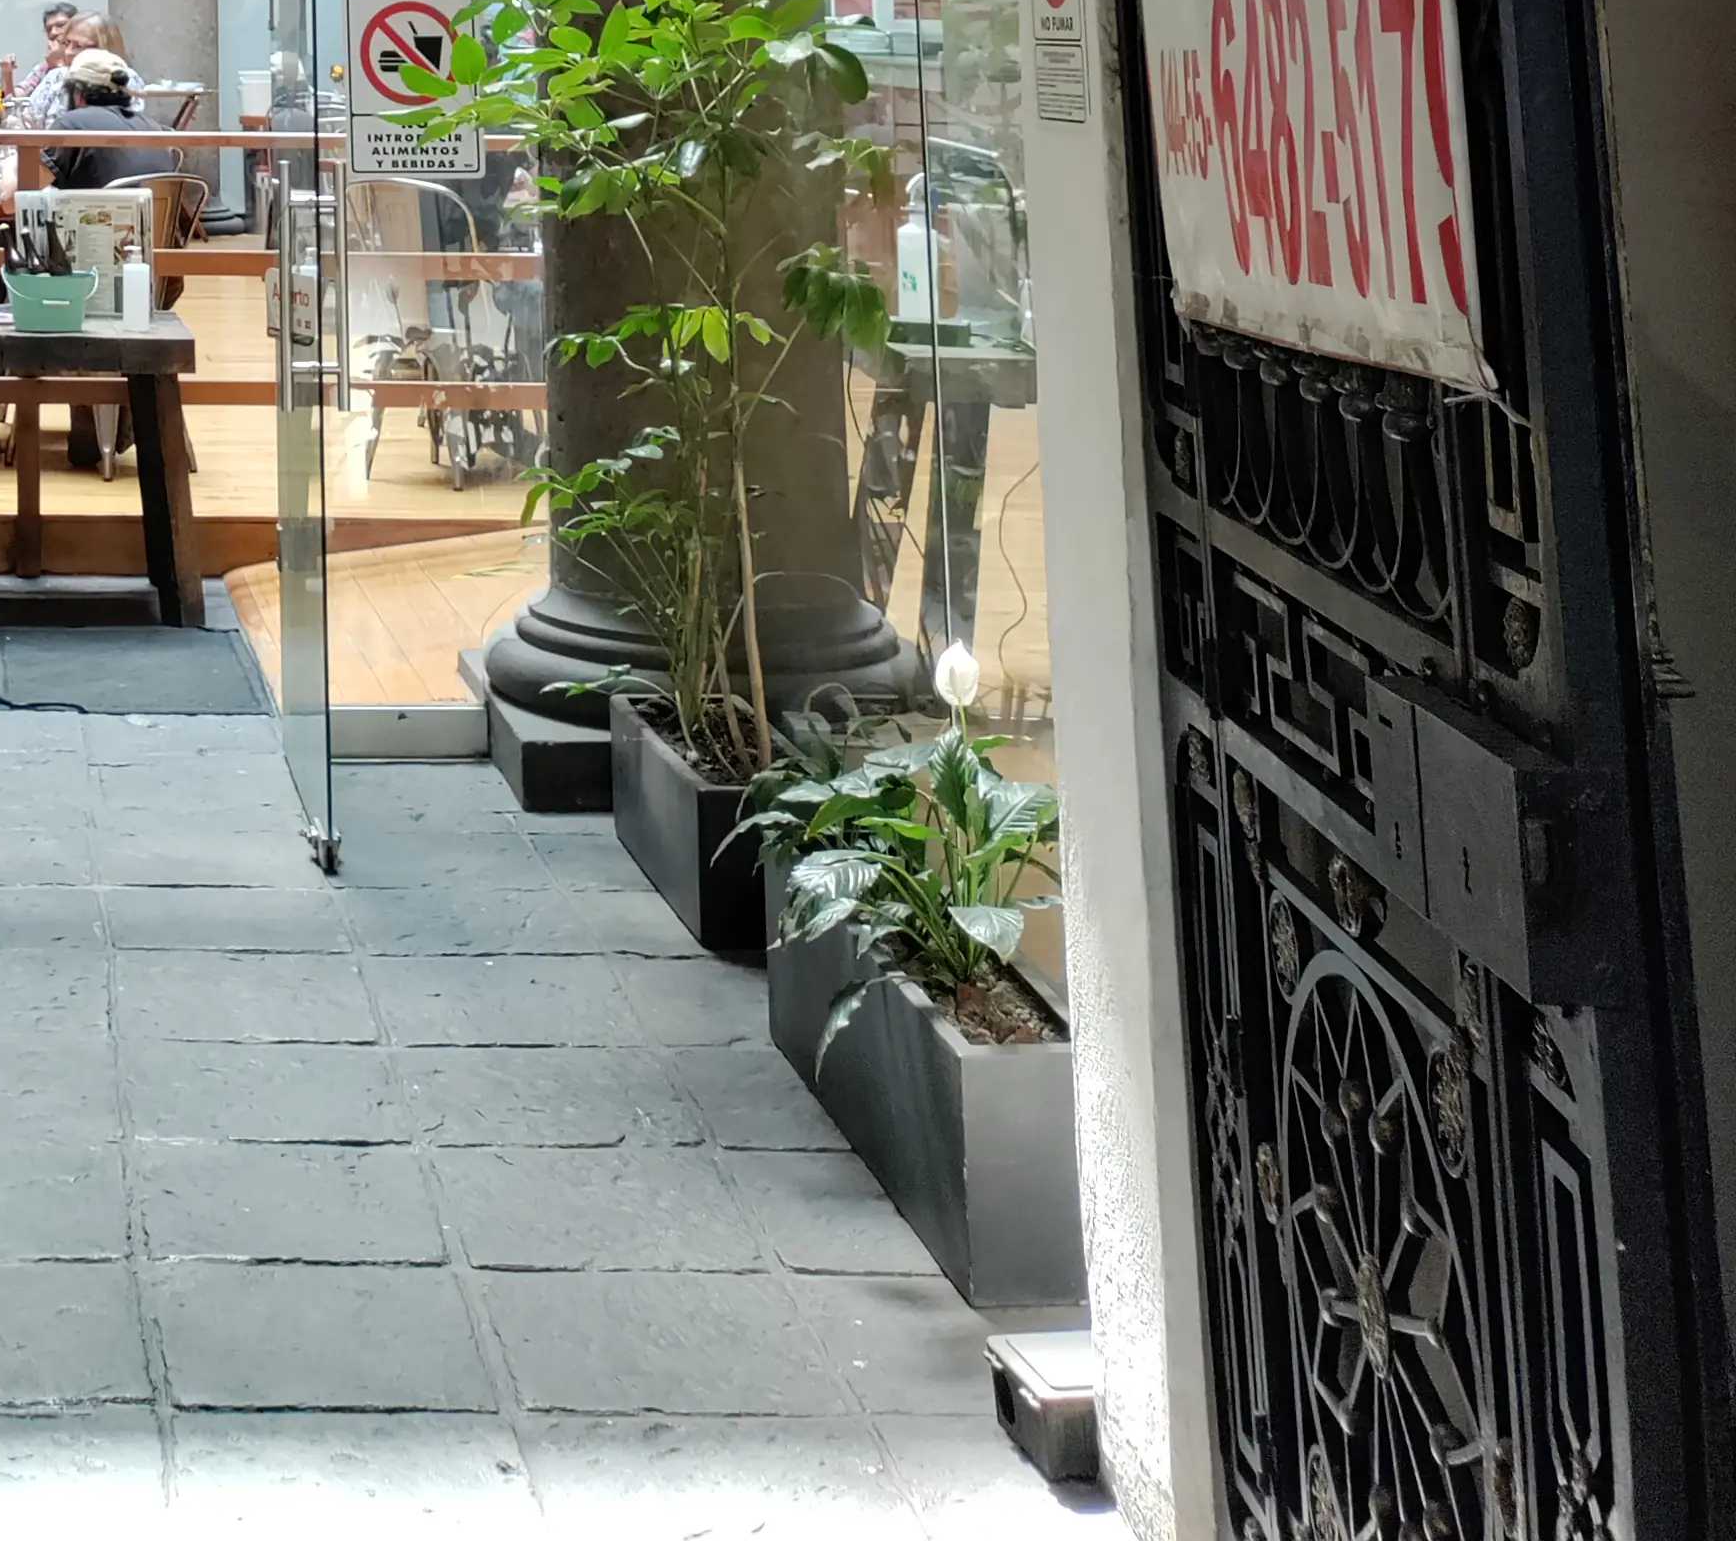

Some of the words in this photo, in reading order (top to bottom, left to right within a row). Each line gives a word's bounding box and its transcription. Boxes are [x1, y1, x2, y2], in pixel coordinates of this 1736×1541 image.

[1040, 16, 1050, 31] NO
[1052, 16, 1074, 31] FUMAR
[371, 146, 460, 156] ALIMENTOS
[376, 160, 385, 169] Y
[391, 159, 456, 169] BEBIDAS
